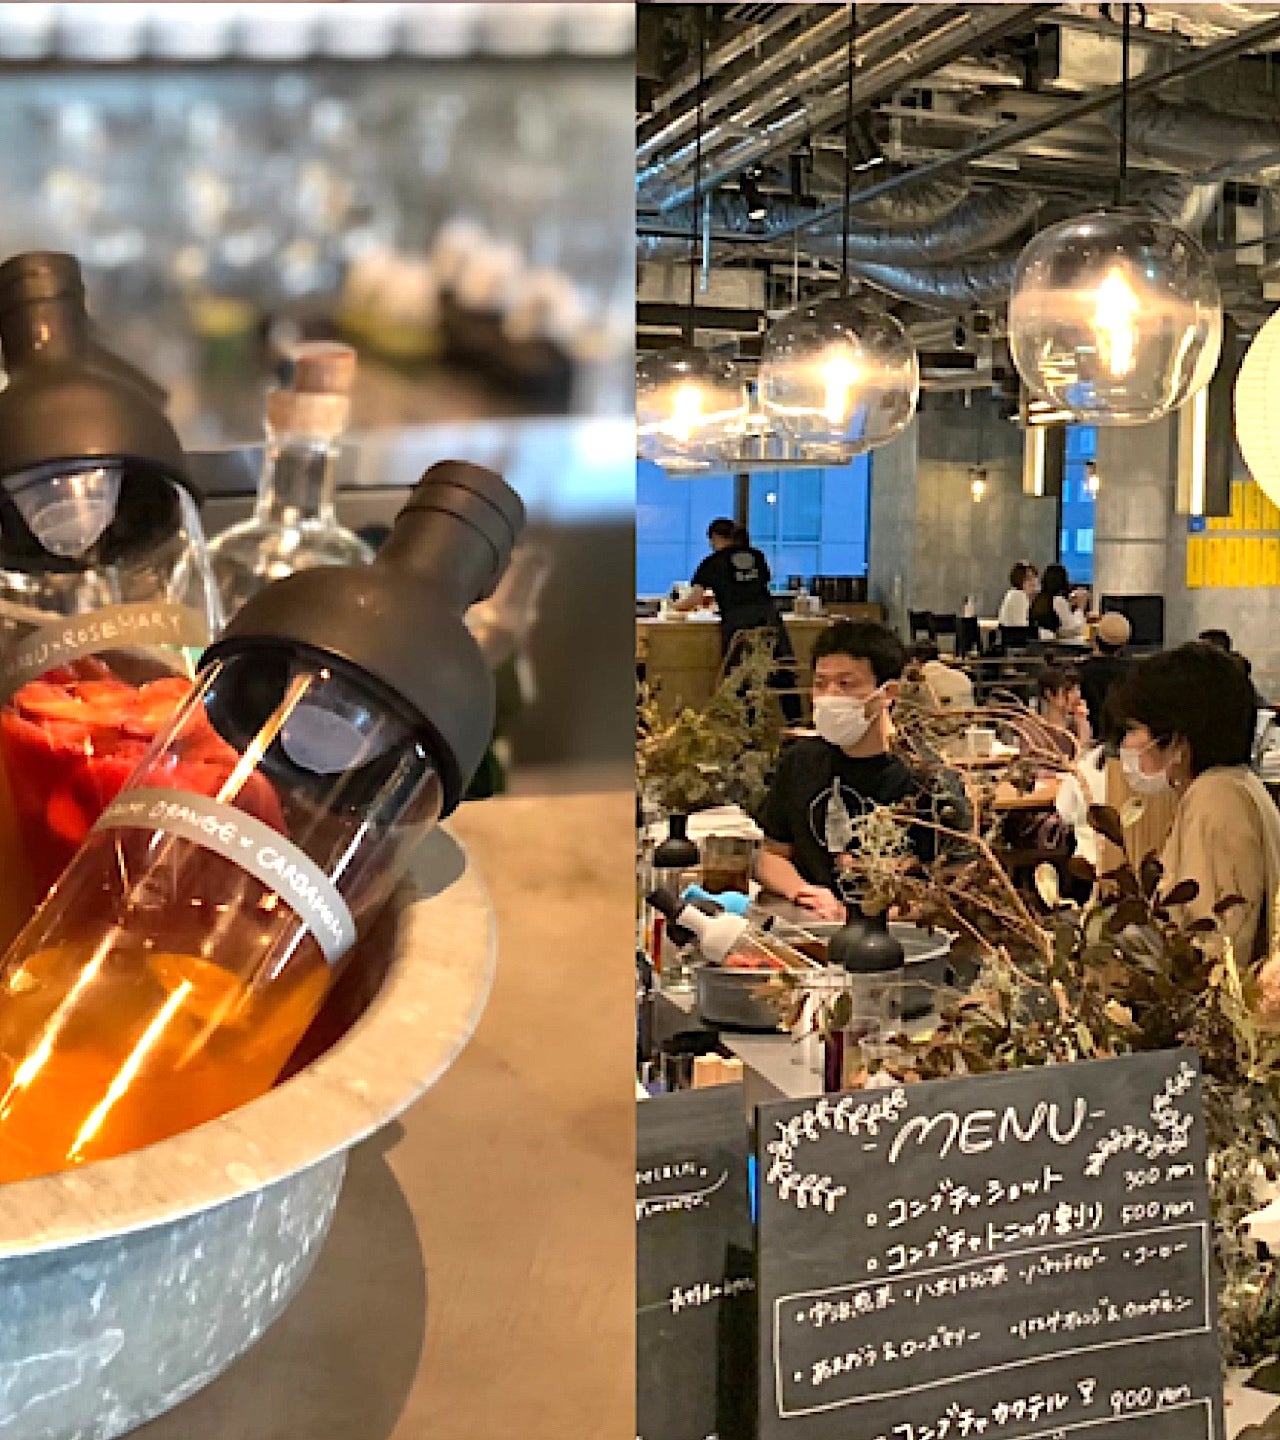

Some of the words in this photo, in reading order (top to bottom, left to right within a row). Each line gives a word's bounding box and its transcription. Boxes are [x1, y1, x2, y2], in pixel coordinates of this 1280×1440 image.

[889, 1096, 1088, 1164] MENU
[1123, 1167, 1160, 1191] 300
[1122, 1203, 1158, 1225] 500
[1111, 1386, 1152, 1416] 900
